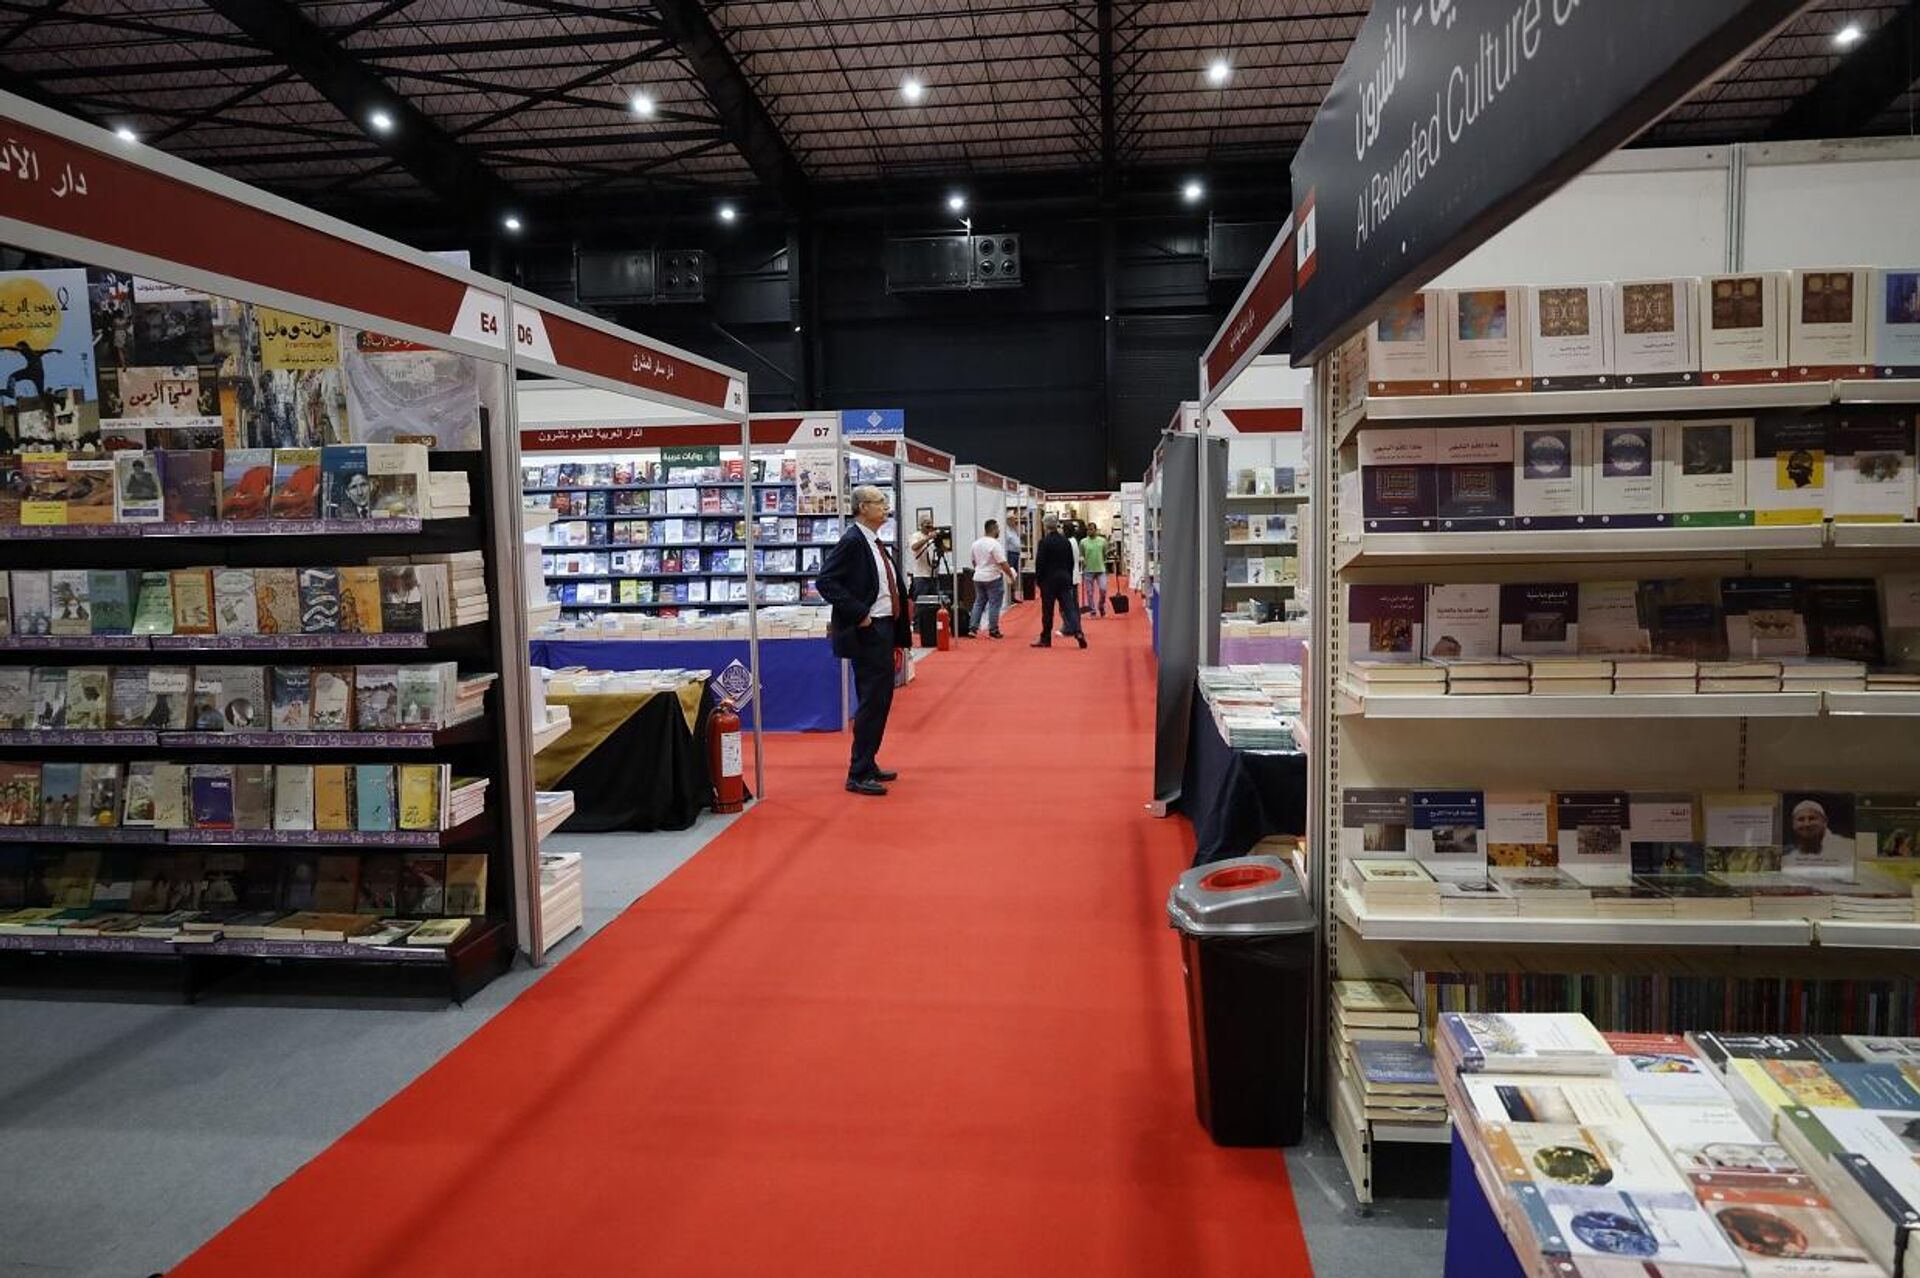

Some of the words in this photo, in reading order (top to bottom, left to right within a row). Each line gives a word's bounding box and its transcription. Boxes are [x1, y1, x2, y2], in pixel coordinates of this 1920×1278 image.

[1355, 183, 1368, 250] Al
[1371, 91, 1441, 232] Rawafed
[1447, 0, 1542, 145] Culture
[50, 162, 88, 198] دار
[480, 312, 498, 336] E4
[517, 324, 533, 346] D6
[129, 381, 163, 407] الزمن
[168, 381, 193, 409] ملجأ
[538, 431, 569, 442] ناشرون
[571, 430, 594, 443] للعلوم
[596, 428, 623, 442] العربية
[626, 427, 643, 440] الدار
[813, 427, 830, 438] D7
[662, 452, 681, 462] عربية
[681, 451, 703, 463] روايات
